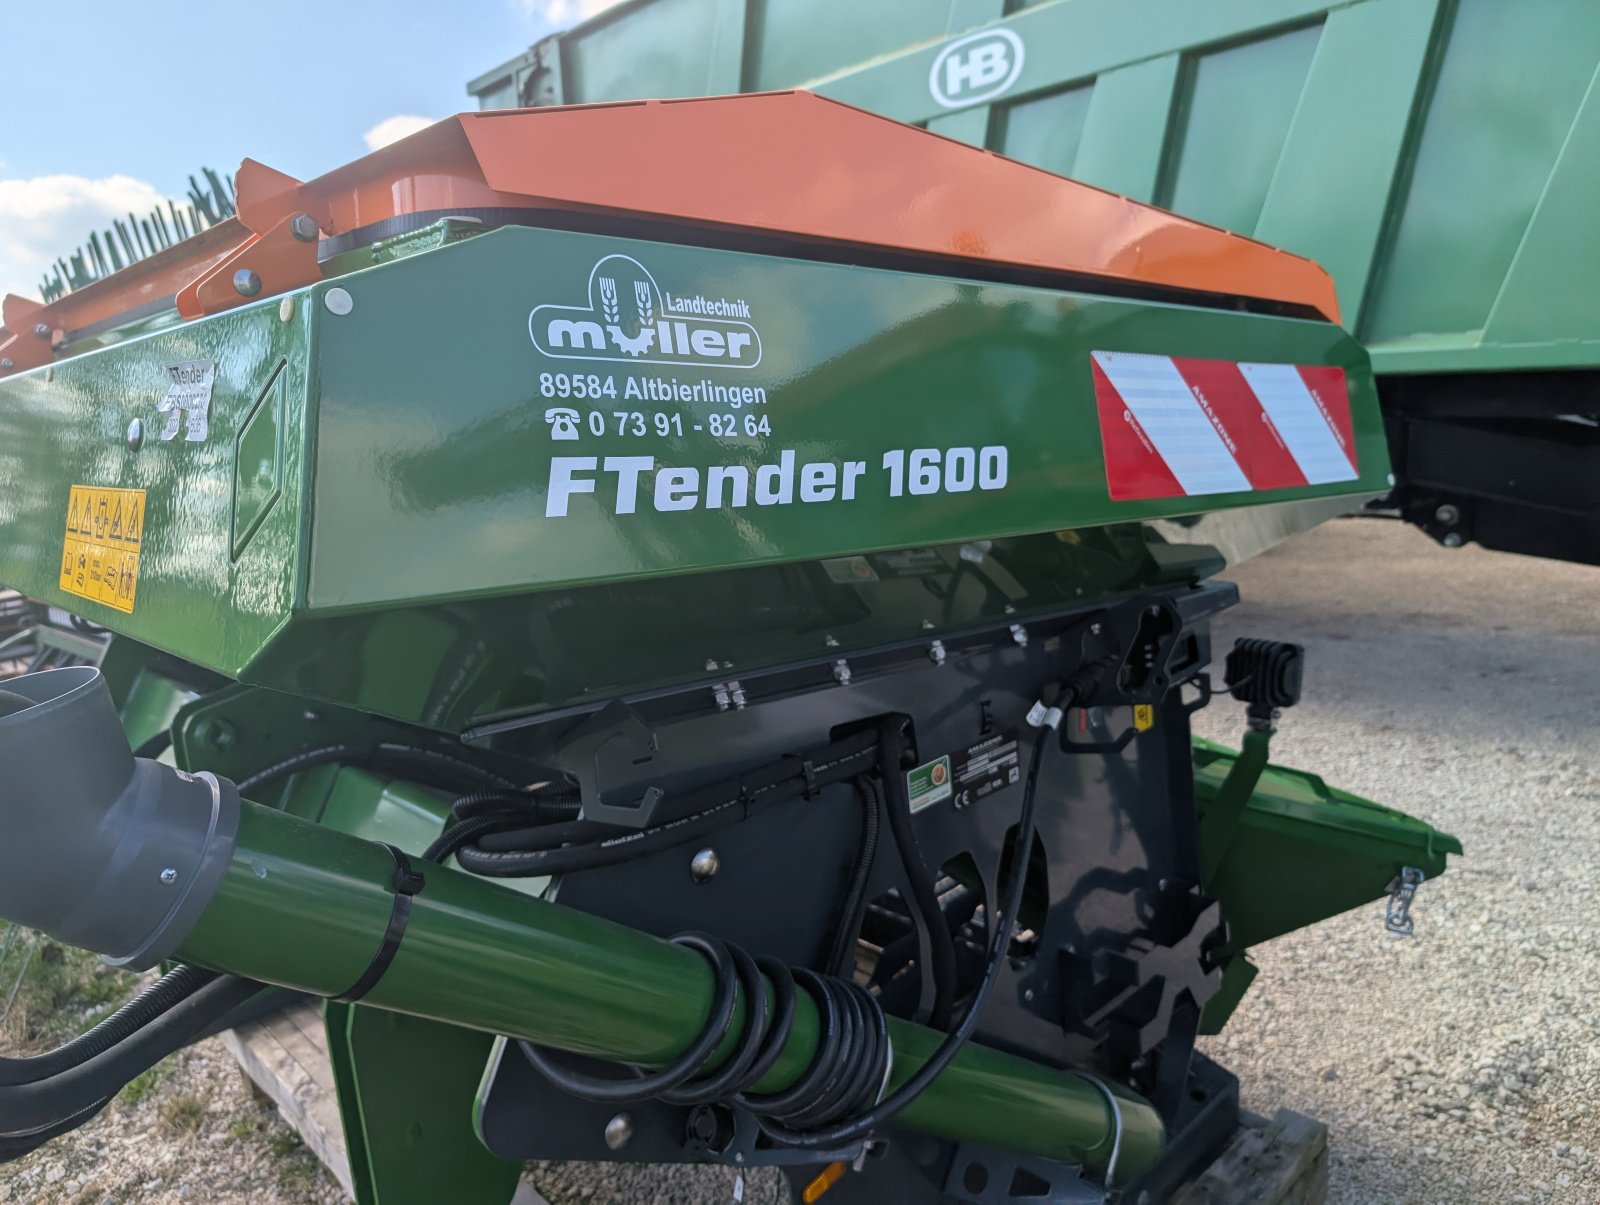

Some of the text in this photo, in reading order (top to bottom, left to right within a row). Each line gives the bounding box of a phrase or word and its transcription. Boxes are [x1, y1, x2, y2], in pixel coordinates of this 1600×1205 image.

[946, 42, 1009, 96] HB
[665, 292, 751, 318] Landtechnik
[539, 372, 767, 408] 89584 Altbierlingen
[588, 411, 605, 436] 0
[613, 411, 647, 437] 73
[655, 412, 683, 437] 91
[708, 414, 738, 437] 82
[744, 414, 772, 437] 64
[1192, 386, 1237, 454] AMAZONE
[545, 445, 1008, 518] FTender 1600
